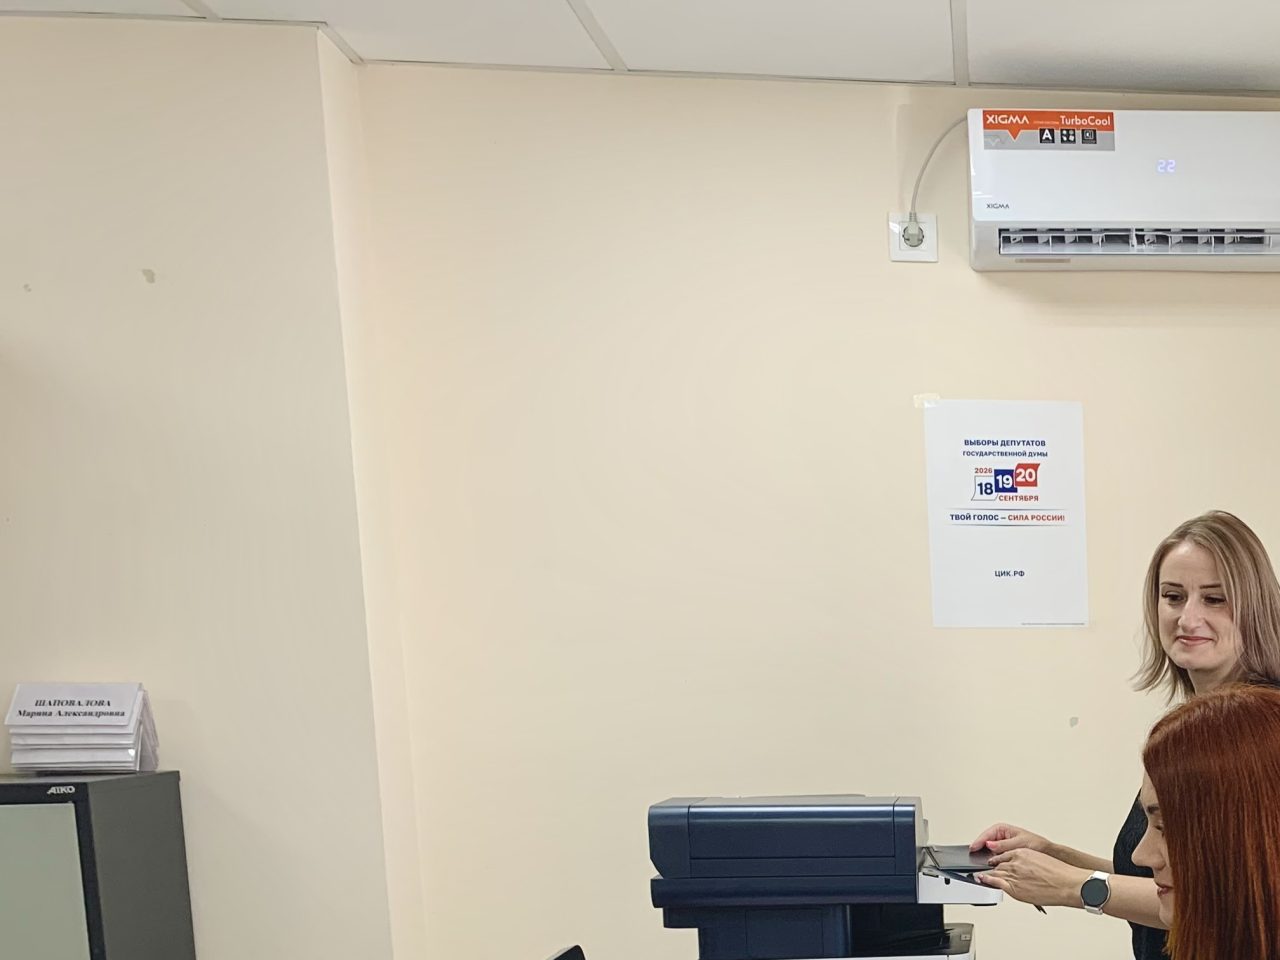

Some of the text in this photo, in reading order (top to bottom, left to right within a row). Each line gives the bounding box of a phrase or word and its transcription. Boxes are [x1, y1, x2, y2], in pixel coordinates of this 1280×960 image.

[986, 114, 1029, 124] XIGMA
[1060, 115, 1111, 126] TurboCool
[1158, 159, 1176, 172] 22
[964, 439, 999, 447] ВЫБОРЫ
[977, 468, 1036, 495] 18 19 20
[950, 513, 972, 521] ТВОЙ
[34, 699, 111, 707] ШАПОВАЛОВА
[16, 709, 126, 718] Марина Александровна
[47, 785, 76, 794] AIKO
